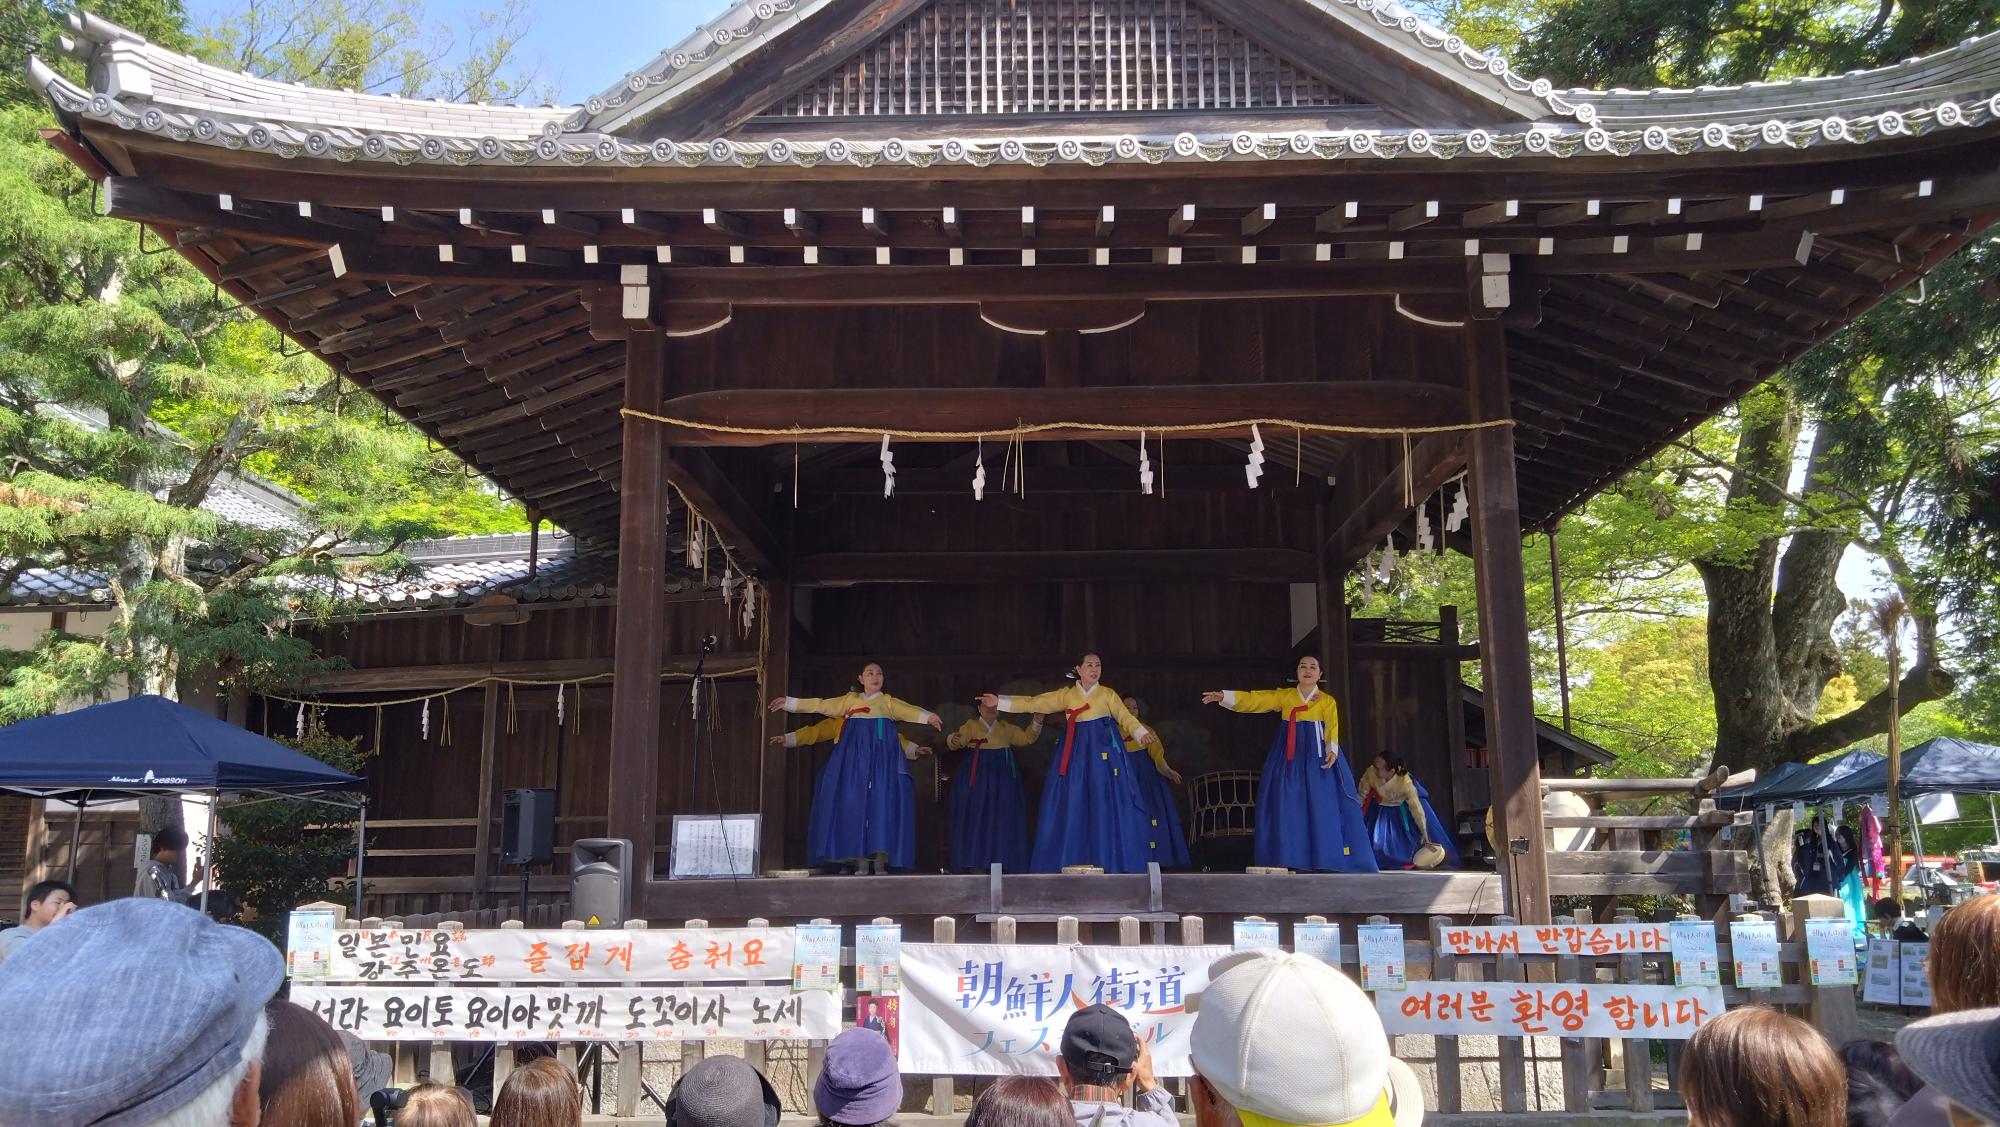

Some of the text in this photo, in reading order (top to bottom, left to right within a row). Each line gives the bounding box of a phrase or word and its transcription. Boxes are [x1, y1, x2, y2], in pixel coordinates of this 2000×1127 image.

[1447, 930, 1519, 955] 만나서
[1536, 928, 1668, 955] 반갑습니다
[956, 959, 1186, 1022] 朝鮮人街道
[382, 995, 454, 1028] 요이토
[752, 996, 802, 1027] 노세
[1401, 989, 1708, 1032] 여러분 환영 합니다
[961, 1022, 1176, 1057] フェスル
